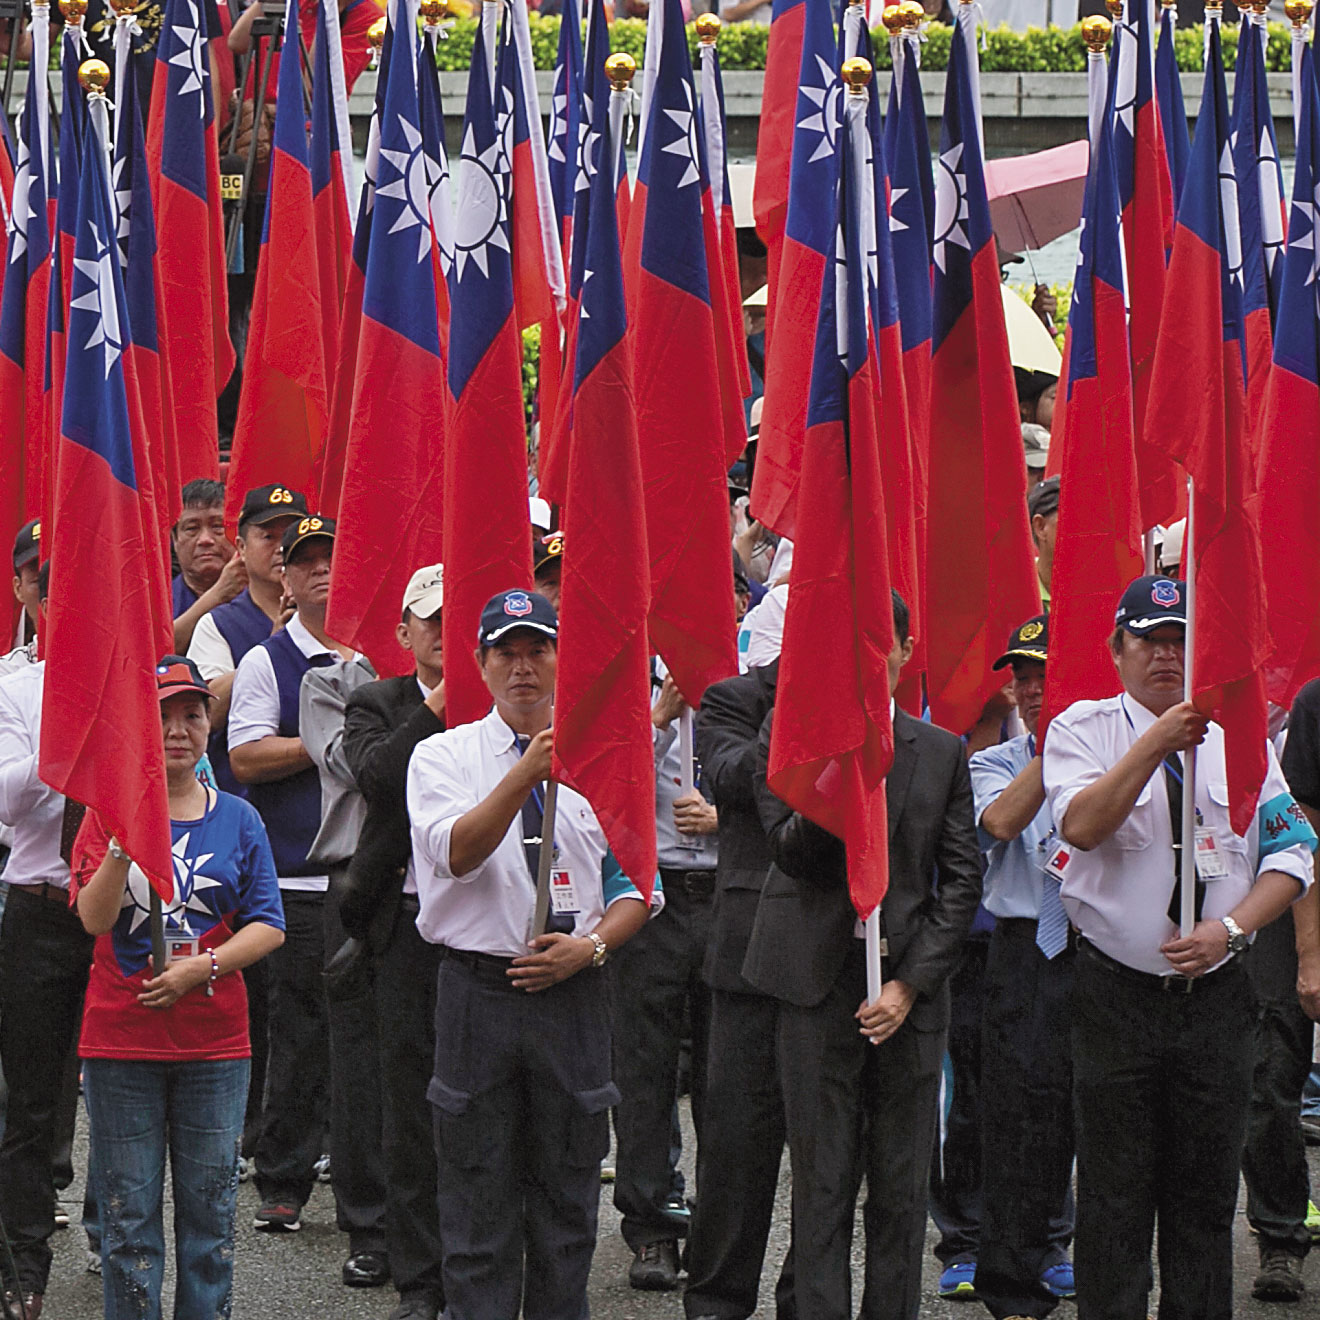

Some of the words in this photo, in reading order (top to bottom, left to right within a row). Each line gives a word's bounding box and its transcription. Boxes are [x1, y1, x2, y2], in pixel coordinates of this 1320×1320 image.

[269, 488, 293, 504] 69
[298, 517, 324, 535] 69
[547, 537, 565, 555] 6
